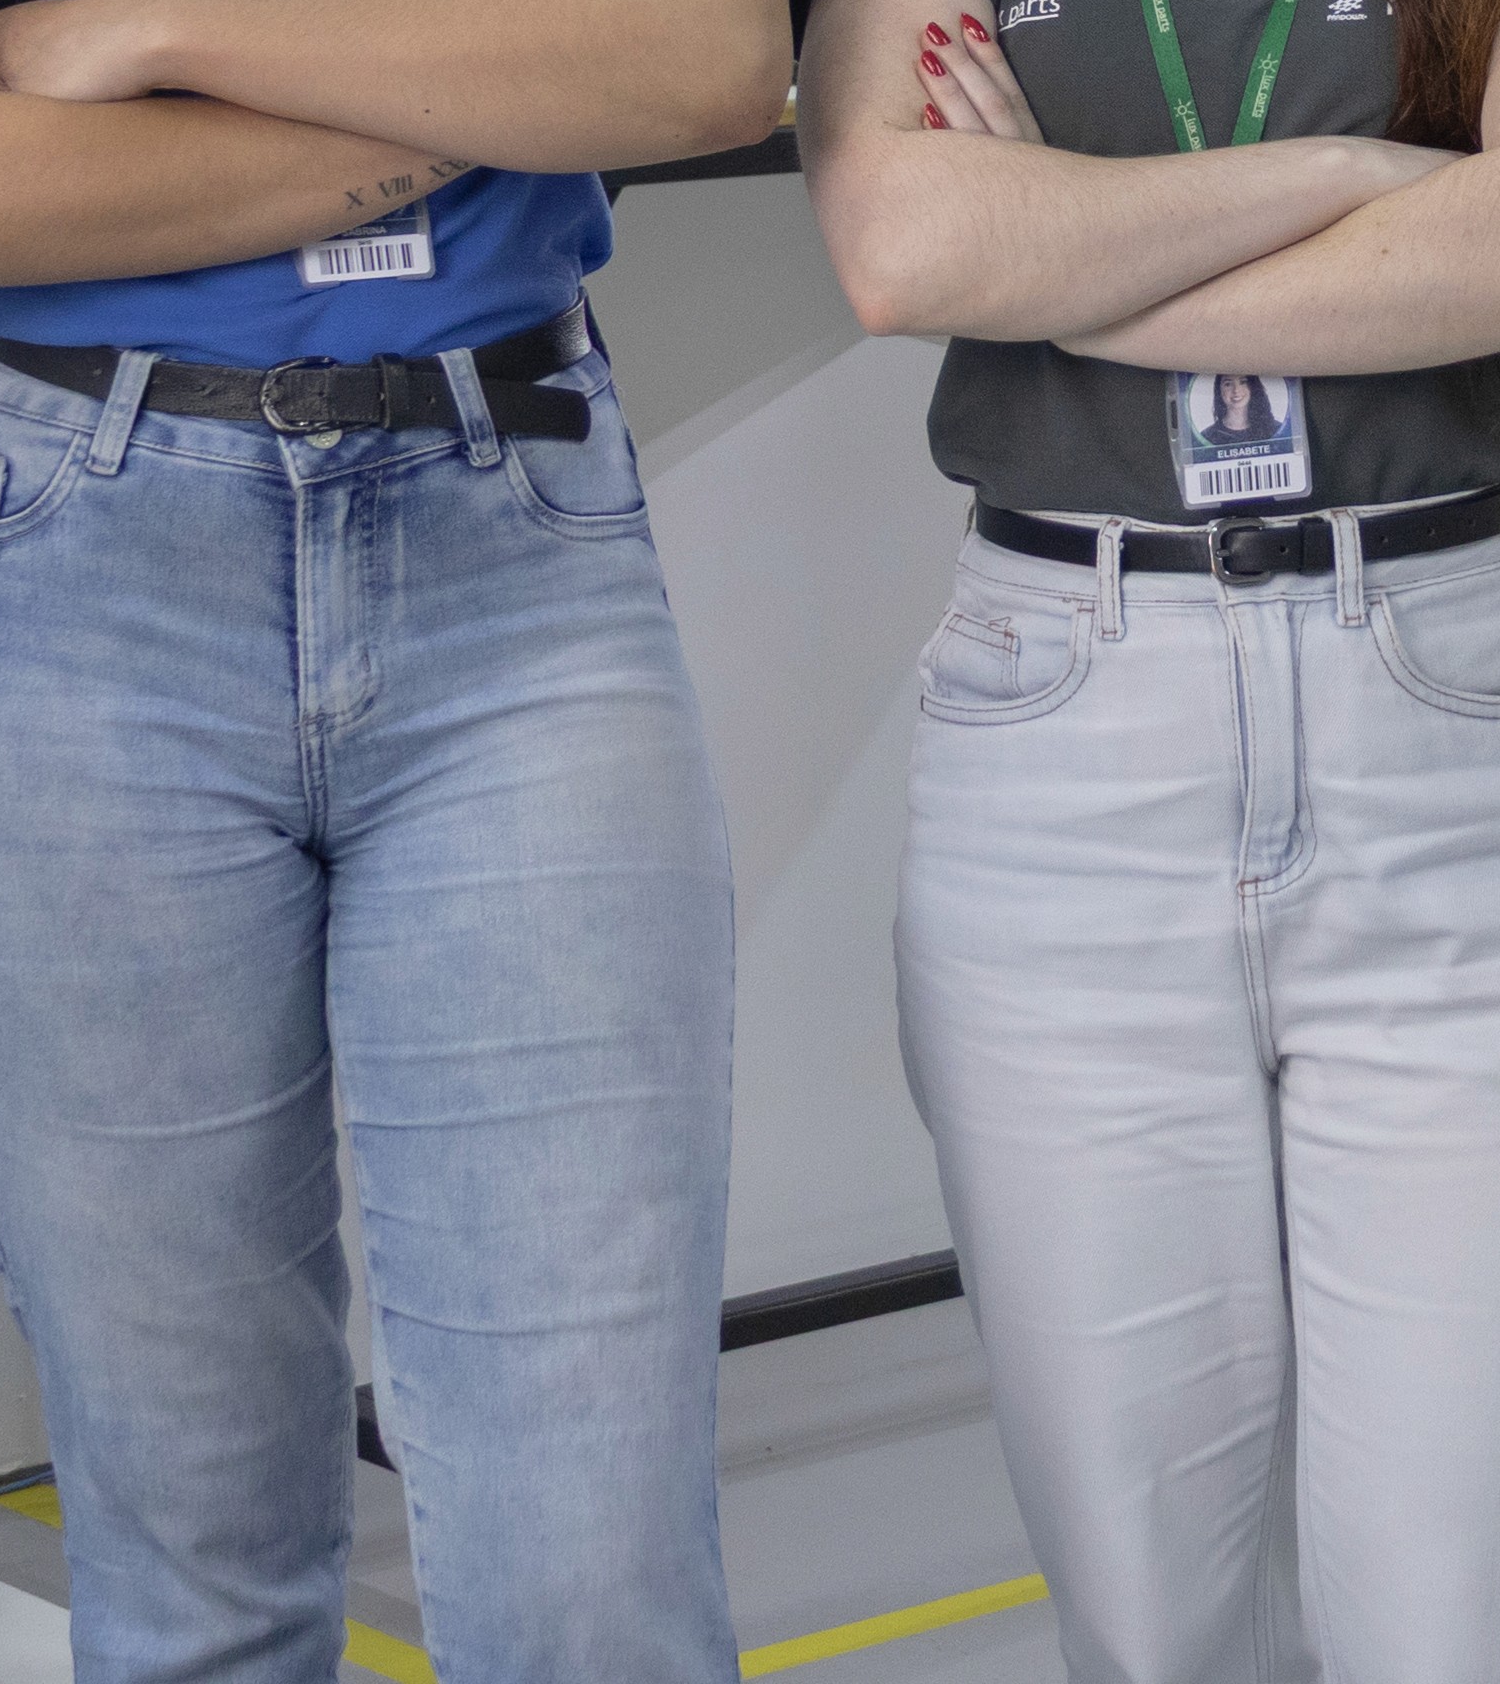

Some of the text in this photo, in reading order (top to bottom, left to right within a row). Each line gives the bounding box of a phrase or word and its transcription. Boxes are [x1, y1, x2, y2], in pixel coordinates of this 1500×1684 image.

[1157, 7, 1171, 33] parts
[1254, 92, 1268, 119] parts
[344, 187, 366, 210] X
[377, 174, 415, 198] VIII
[1217, 444, 1271, 459] ELISABETE
